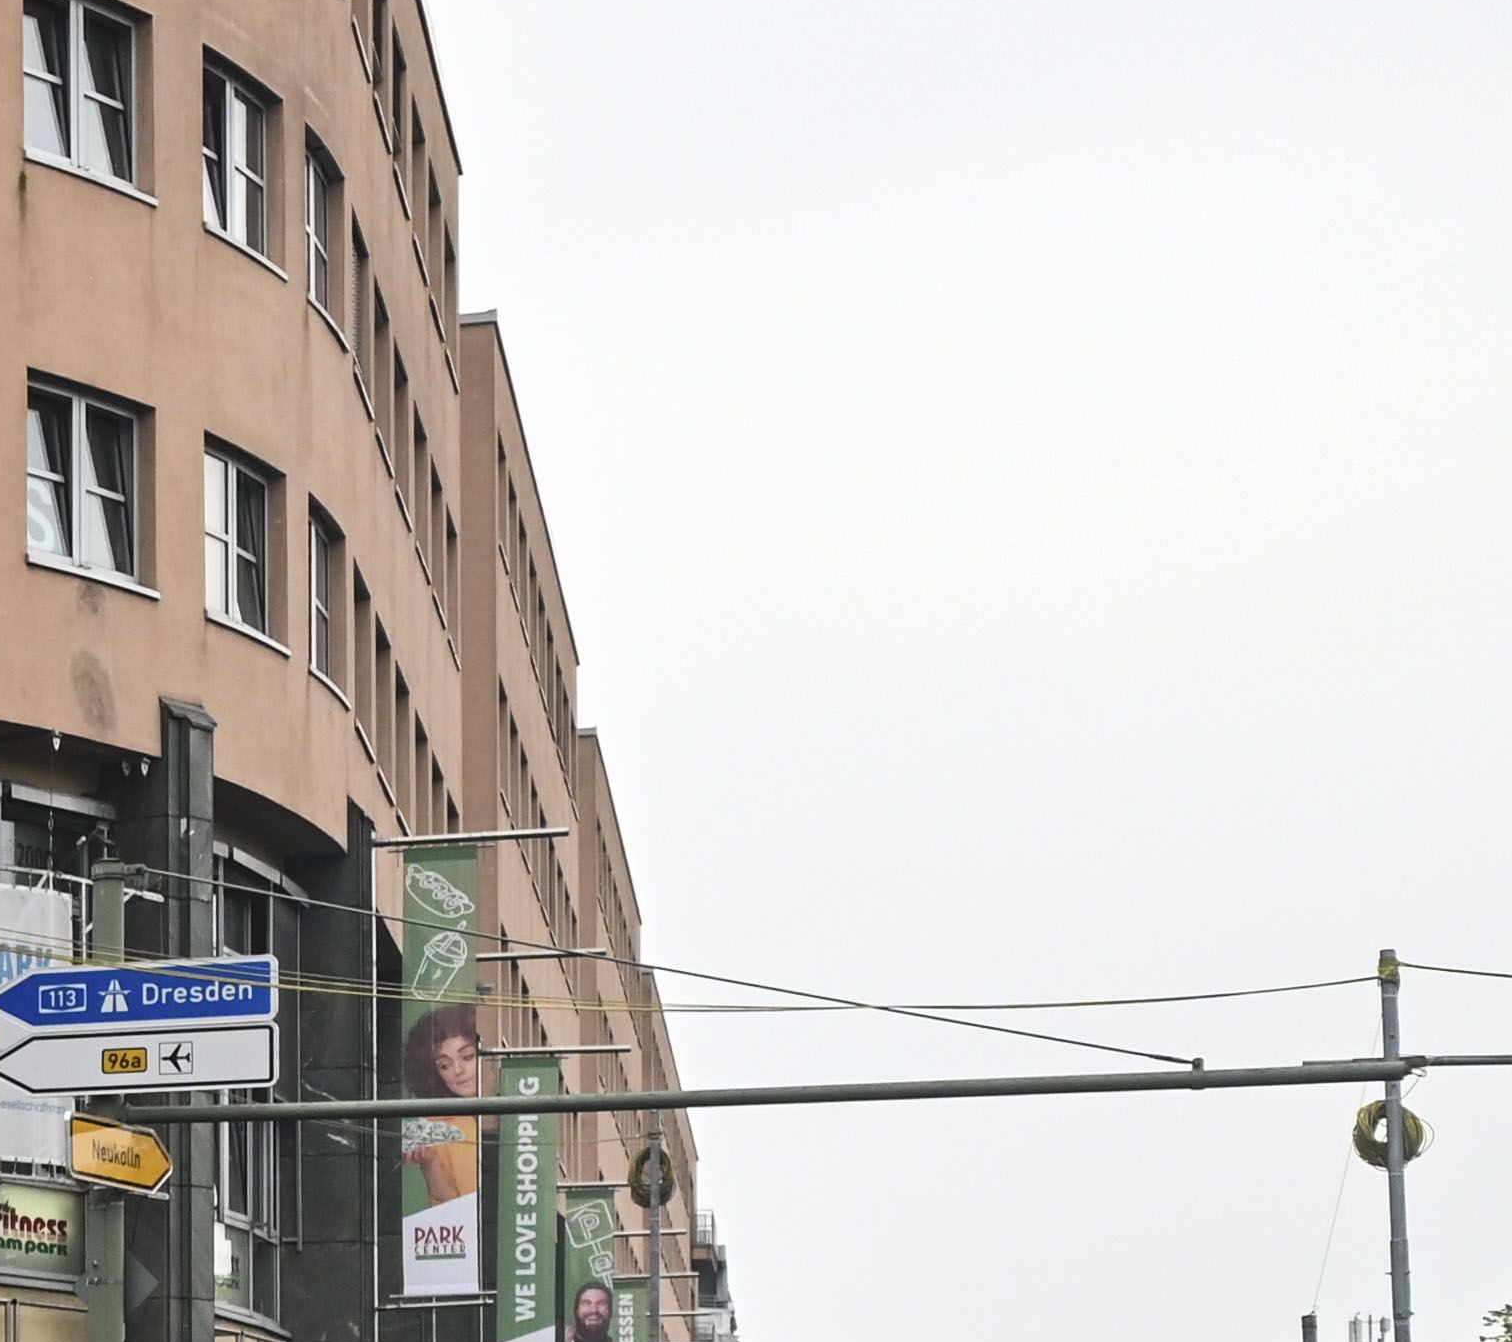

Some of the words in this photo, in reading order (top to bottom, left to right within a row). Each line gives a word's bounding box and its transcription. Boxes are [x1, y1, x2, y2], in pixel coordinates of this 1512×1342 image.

[48, 988, 77, 1008] 113
[142, 980, 254, 1006] Dresden
[107, 1052, 142, 1070] 96a
[91, 1138, 141, 1170] Neukölln
[516, 1076, 541, 1206] SHOPPIG
[414, 1225, 464, 1245] PARK
[515, 1212, 537, 1280] LOVE
[514, 1283, 537, 1323] WE
